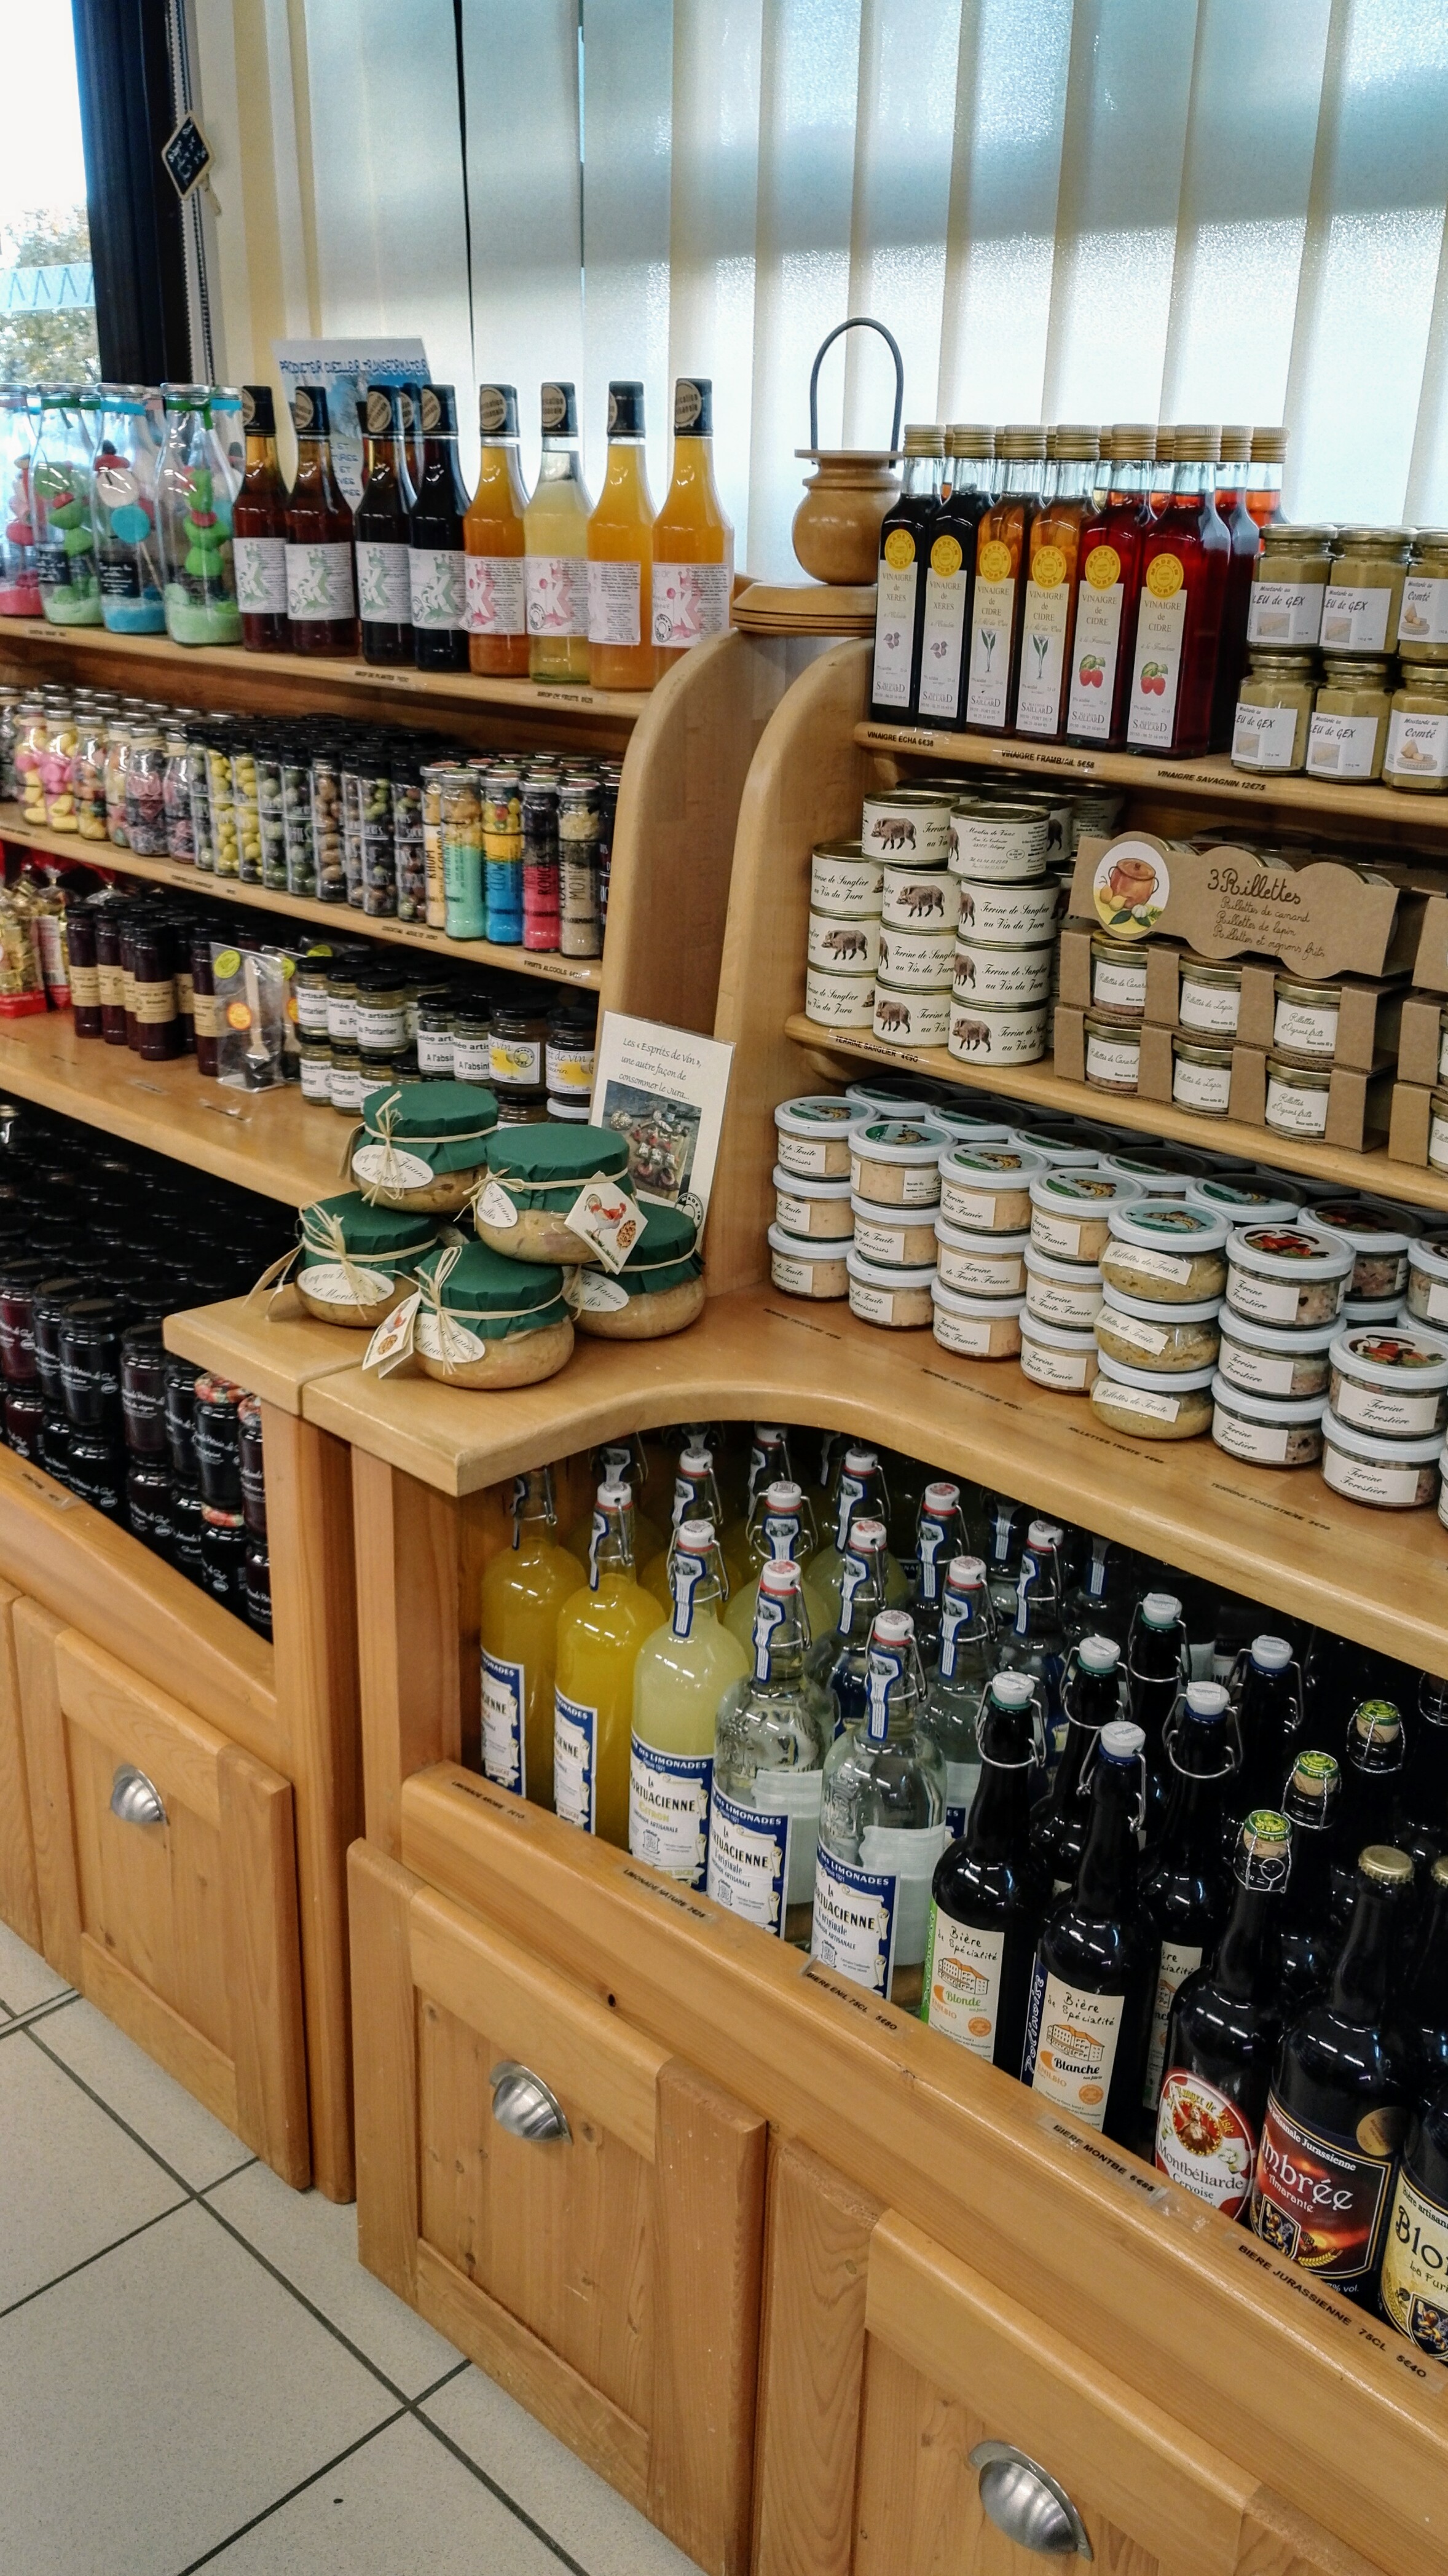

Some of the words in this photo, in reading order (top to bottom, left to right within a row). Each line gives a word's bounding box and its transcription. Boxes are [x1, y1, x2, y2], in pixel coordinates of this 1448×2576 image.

[882, 572, 913, 582] VINAIGRE
[886, 593, 907, 602] XERES
[1252, 595, 1269, 605] LEU
[1272, 597, 1283, 605] de
[1286, 596, 1305, 608] GEX
[1337, 600, 1347, 609] de
[1348, 601, 1368, 613] GEX
[982, 607, 1002, 616] CIDRE
[867, 731, 897, 742] VINAIGRE
[899, 737, 917, 745] ECHA
[1405, 728, 1436, 739] Comté
[1001, 750, 1034, 761] VINAIGRE
[1036, 754, 1075, 766] FRAMB/AIL
[1077, 759, 1095, 769] 5€58
[1157, 770, 1194, 782] VINAIGRE
[1195, 774, 1240, 788] SAVAGNIN
[1241, 782, 1267, 791] 12€75
[1219, 868, 1301, 905] Rillettes
[980, 901, 1007, 915] Terrine
[1009, 905, 1018, 915] de
[1220, 896, 1259, 914] Rillettes
[1261, 905, 1272, 916] de
[1275, 909, 1310, 923] canard
[997, 917, 1011, 929] Vin
[1013, 919, 1024, 930] du
[1026, 918, 1045, 933] Jura
[1216, 910, 1256, 930] Rillettes
[1258, 921, 1269, 932] de
[1272, 921, 1296, 939] lapin
[1213, 924, 1253, 944] Rillettes
[1256, 935, 1265, 946] et
[1268, 940, 1302, 957] oignons
[1301, 941, 1325, 960] frits
[892, 946, 916, 959] Terrine
[918, 949, 927, 959] de
[928, 949, 956, 962] Sangli
[524, 960, 541, 970] FRUITS
[543, 964, 567, 976] ALCOOLS
[1098, 973, 1117, 988] Rillettes
[1119, 978, 1125, 987] de
[812, 999, 821, 1010] Vin
[822, 1003, 832, 1012] du
[832, 1003, 853, 1015] Jura
[1186, 993, 1205, 1008] Rillettes
[1213, 1000, 1234, 1014] Lapin
[1289, 1012, 1315, 1026] Rillettes
[1307, 1028, 1324, 1040] frits
[623, 1038, 636, 1048] Les
[641, 1042, 671, 1057] Esprits
[671, 1048, 681, 1061] de
[682, 1053, 695, 1066] vin
[835, 1035, 862, 1048] TERRINE
[864, 1042, 897, 1058] SANGLIER
[621, 1056, 635, 1066] une
[635, 1060, 655, 1072] autre
[653, 1063, 676, 1078] façon
[677, 1070, 687, 1081] de
[1115, 1054, 1139, 1066] Canard
[619, 1072, 659, 1090] consommer
[659, 1082, 666, 1093] le
[398, 1156, 428, 1181] Jaune
[782, 1201, 802, 1214] Truite
[944, 1190, 965, 1205] Terrine
[941, 1198, 955, 1211] Truite
[955, 1206, 983, 1220] Fumée
[1109, 1249, 1140, 1264] Rillettes
[1141, 1257, 1152, 1266] de
[1152, 1260, 1180, 1275] Truite
[954, 1271, 979, 1283] Truite
[980, 1275, 1010, 1285] Fumée
[593, 1280, 623, 1306] Jaune
[1231, 1288, 1269, 1310] Forestière
[920, 1367, 949, 1382] TERRINE
[1068, 1426, 1111, 1445] RILLETTES
[1112, 1442, 1141, 1456] TRUITE
[1210, 1482, 1247, 1499] TERRINE
[1248, 1496, 1305, 1521] FORESTIERE
[650, 1754, 708, 1769] LIMONADES
[631, 1770, 696, 1812] ORTUACIENNE
[710, 1826, 769, 1868] RTUACIENNE
[623, 1868, 658, 1892] LIMONADE
[658, 1888, 687, 1907] NATURE
[725, 1871, 752, 1888] ARTISANALE
[950, 1925, 982, 1947] Bière
[806, 1971, 830, 1989] BIERE
[829, 1986, 848, 2001] ENIL
[848, 1998, 869, 2014] 75CL
[875, 2015, 898, 2031] 5€80
[945, 1990, 982, 2006] Blonde
[1063, 1992, 1100, 2013] Bière
[1047, 1995, 1056, 2008] de
[1062, 2005, 1116, 2026] Spécialité
[1054, 2057, 1101, 2074] Blanche
[1271, 2111, 1302, 2143] artisanale
[1301, 2136, 1357, 2172] Jurassienne
[1053, 2124, 1084, 2145] BIERE
[1083, 2143, 1128, 2175] MONTBE
[1129, 2174, 1156, 2193] 6€85
[1159, 2138, 1244, 2190] Montbéliarde
[1172, 2172, 1214, 2199] Cervoise
[1342, 2283, 1359, 2293] vol.
[1238, 2245, 1273, 2271] BIERE
[1272, 2269, 1353, 2327] JURASSIENNE
[1358, 2328, 1387, 2352] 75CL
[1396, 2355, 1427, 2378] 5€40
